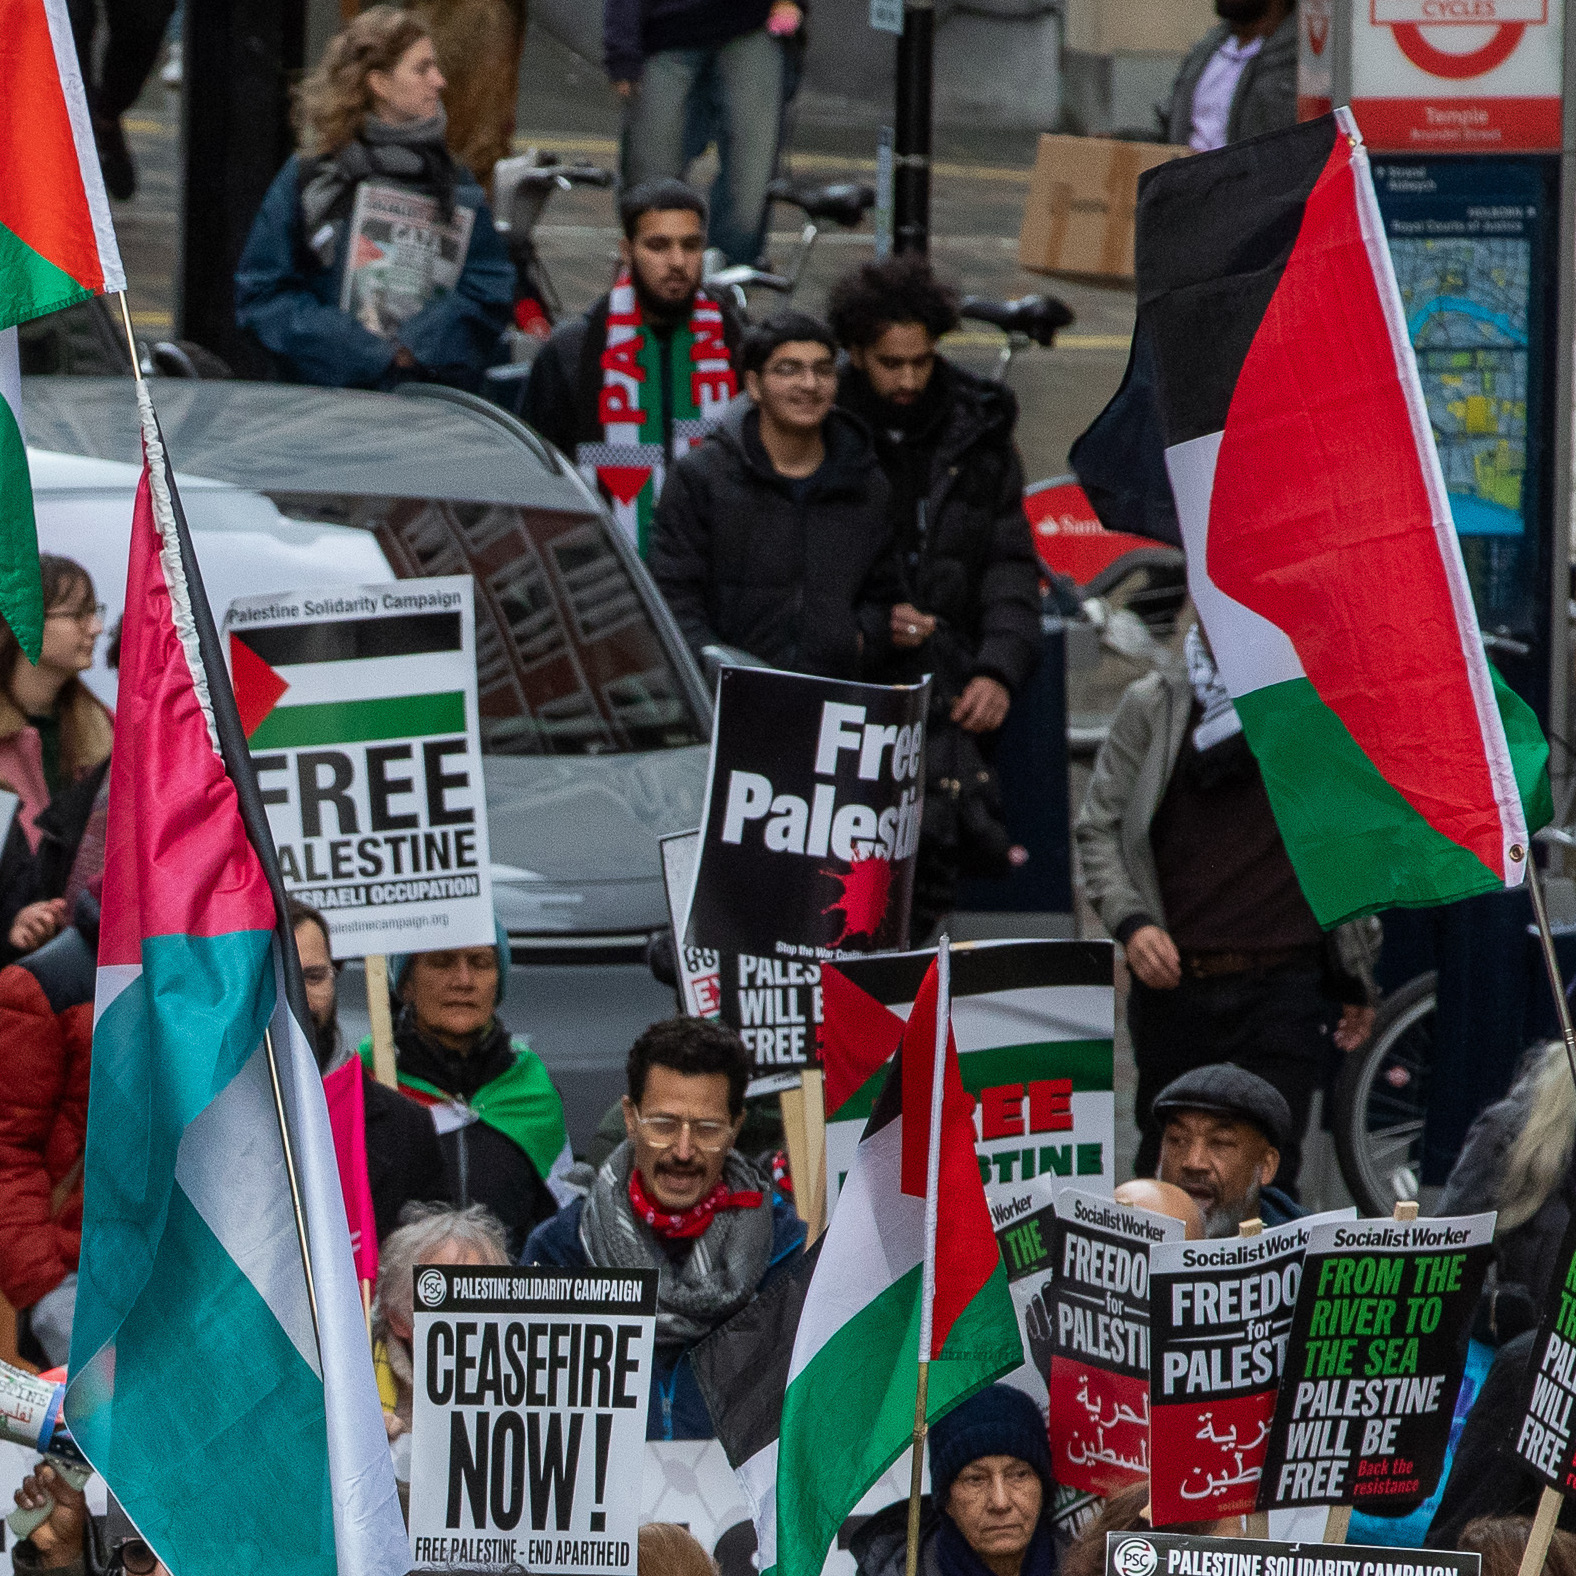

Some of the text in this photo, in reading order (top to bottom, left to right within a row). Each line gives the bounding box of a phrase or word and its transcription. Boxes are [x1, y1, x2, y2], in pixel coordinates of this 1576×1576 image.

[228, 589, 462, 625] Palestine Solidarity Campaign
[250, 738, 476, 838] FREE
[278, 828, 478, 886] ALESTINE
[371, 874, 478, 902] OCCUPATION
[776, 940, 797, 956] Stop
[798, 944, 814, 958] the
[737, 952, 821, 988] PALES
[738, 986, 806, 1027] WILL
[739, 1025, 808, 1065] FREE
[1004, 1218, 1048, 1270] THE
[1062, 1231, 1149, 1300] FREEDO
[1317, 1254, 1467, 1297] FROM THE
[452, 1276, 643, 1302] PALESTINE SOLIDARITY CAMPAIGN
[1105, 1290, 1124, 1317] for
[1171, 1261, 1303, 1327] FREEDO
[1057, 1300, 1150, 1371] PALESTI
[1246, 1317, 1273, 1341] for
[1310, 1296, 1442, 1337] RIVER TO
[425, 1320, 643, 1409] CEASEFIRE
[1163, 1332, 1291, 1395] PALEST
[1304, 1337, 1419, 1378] THE SEA
[1292, 1374, 1446, 1421] PALESTINE
[1529, 1371, 1575, 1438] WILL
[1285, 1417, 1398, 1461] WILL BE
[1516, 1413, 1568, 1481] FREE
[1276, 1460, 1350, 1502] FREE
[1352, 1475, 1420, 1496] resistance
[1357, 1458, 1415, 1478] Back the
[415, 1535, 631, 1568] FREE PALESTINE END APARTHEID
[1122, 1551, 1149, 1570] PSC
